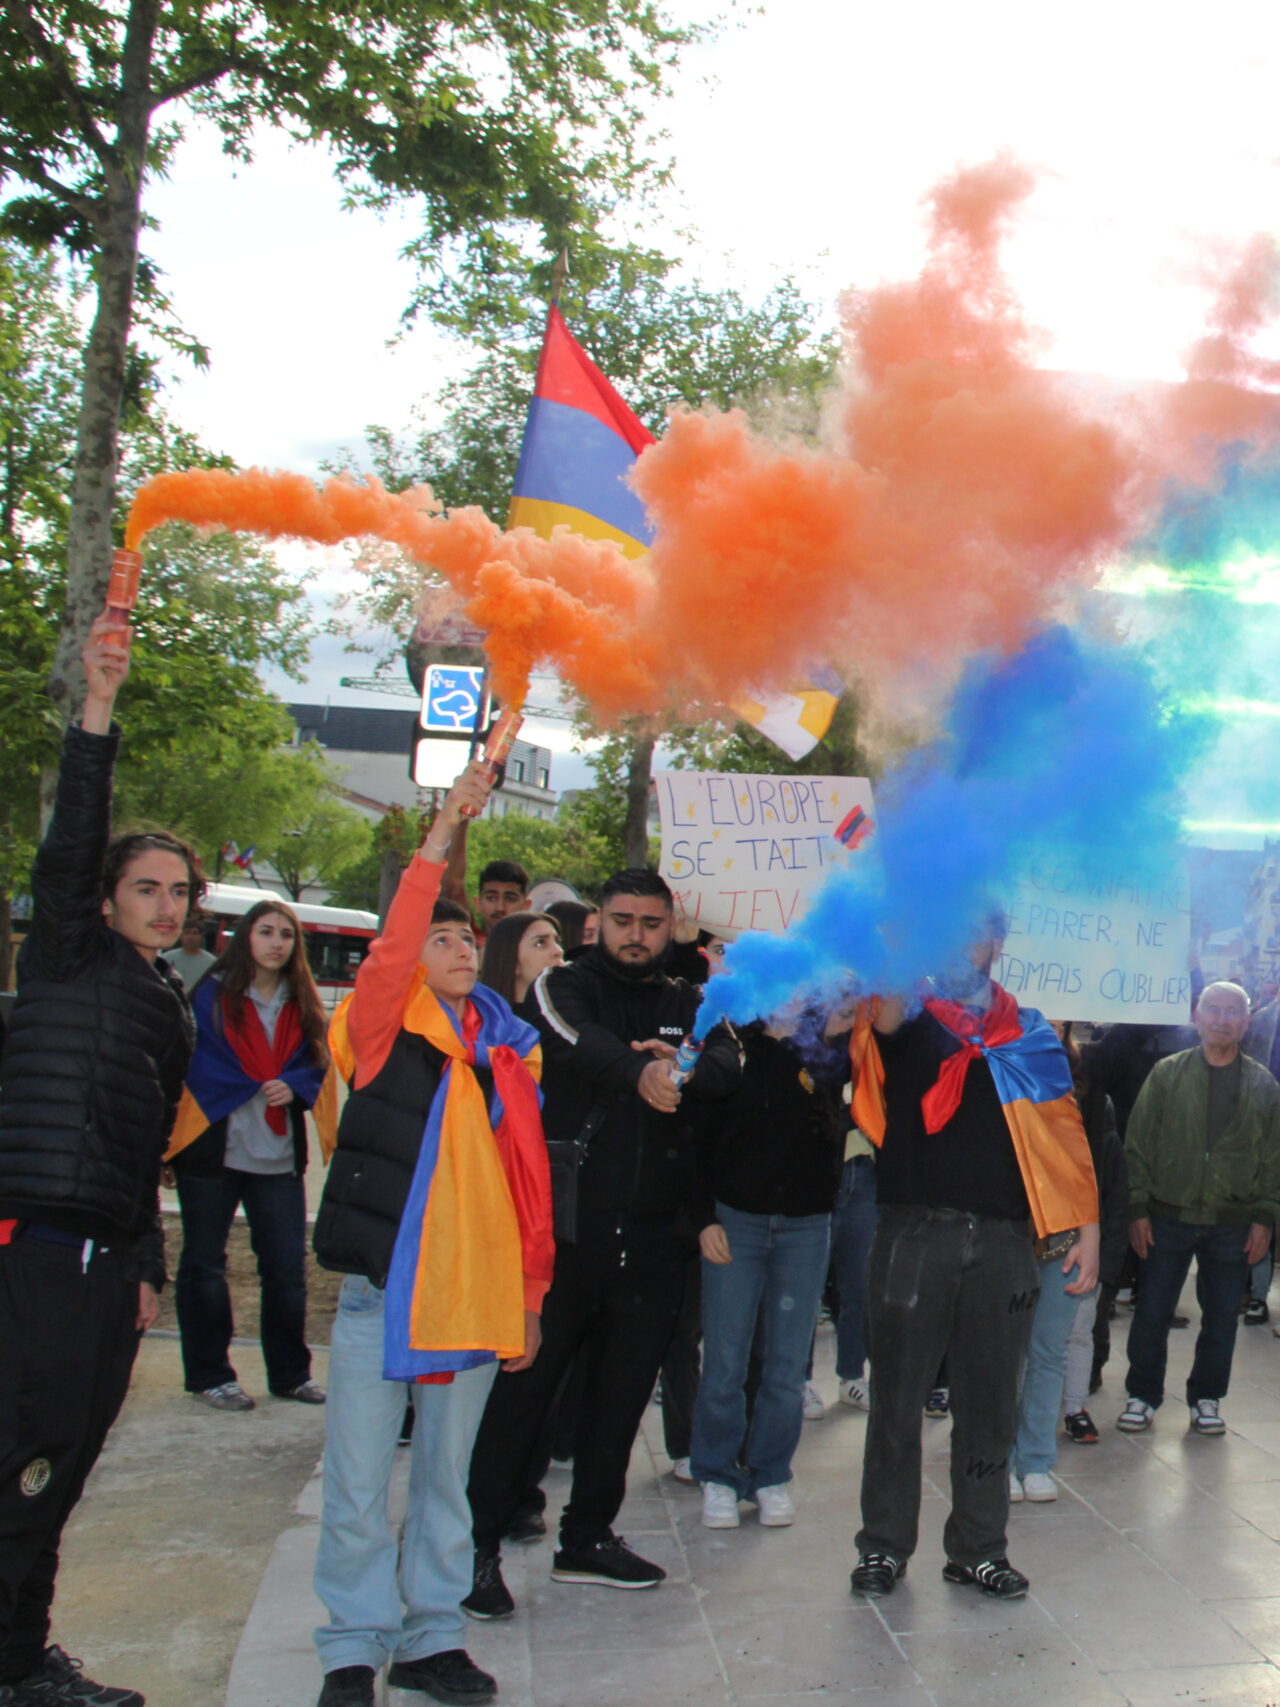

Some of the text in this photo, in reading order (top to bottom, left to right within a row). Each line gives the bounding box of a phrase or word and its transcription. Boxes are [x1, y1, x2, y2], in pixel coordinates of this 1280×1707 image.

[666, 777, 834, 827] L'EUROPE
[668, 836, 829, 879] SE TAIT
[1137, 921, 1168, 947] NE
[999, 952, 1190, 1005] JAMAIS OUBLIER
[659, 1026, 684, 1036] BOSS
